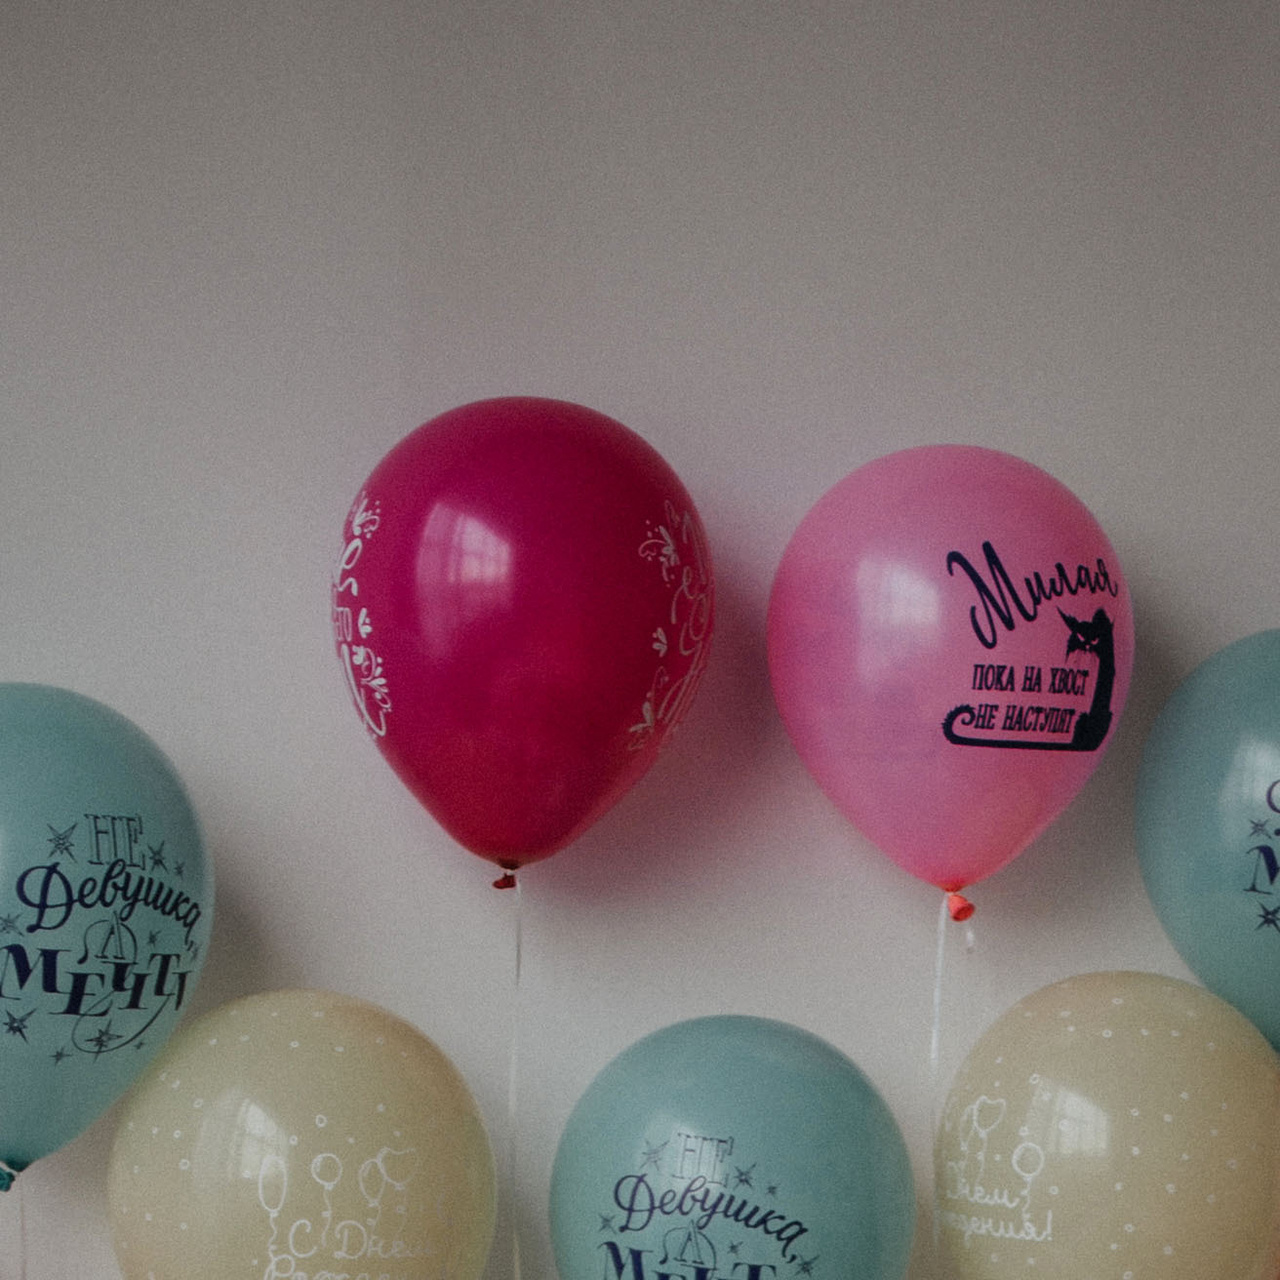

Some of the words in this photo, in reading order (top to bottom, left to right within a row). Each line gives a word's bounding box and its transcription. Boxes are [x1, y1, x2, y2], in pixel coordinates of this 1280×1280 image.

[947, 541, 1118, 649] Милая
[972, 663, 1015, 692] ПОКА
[1021, 665, 1042, 693] НА
[1048, 667, 1089, 696] ХВОСТ
[974, 703, 999, 730] НЕ
[84, 813, 146, 869] НЕ
[671, 1132, 735, 1188] НЕ
[288, 1219, 318, 1259] С
